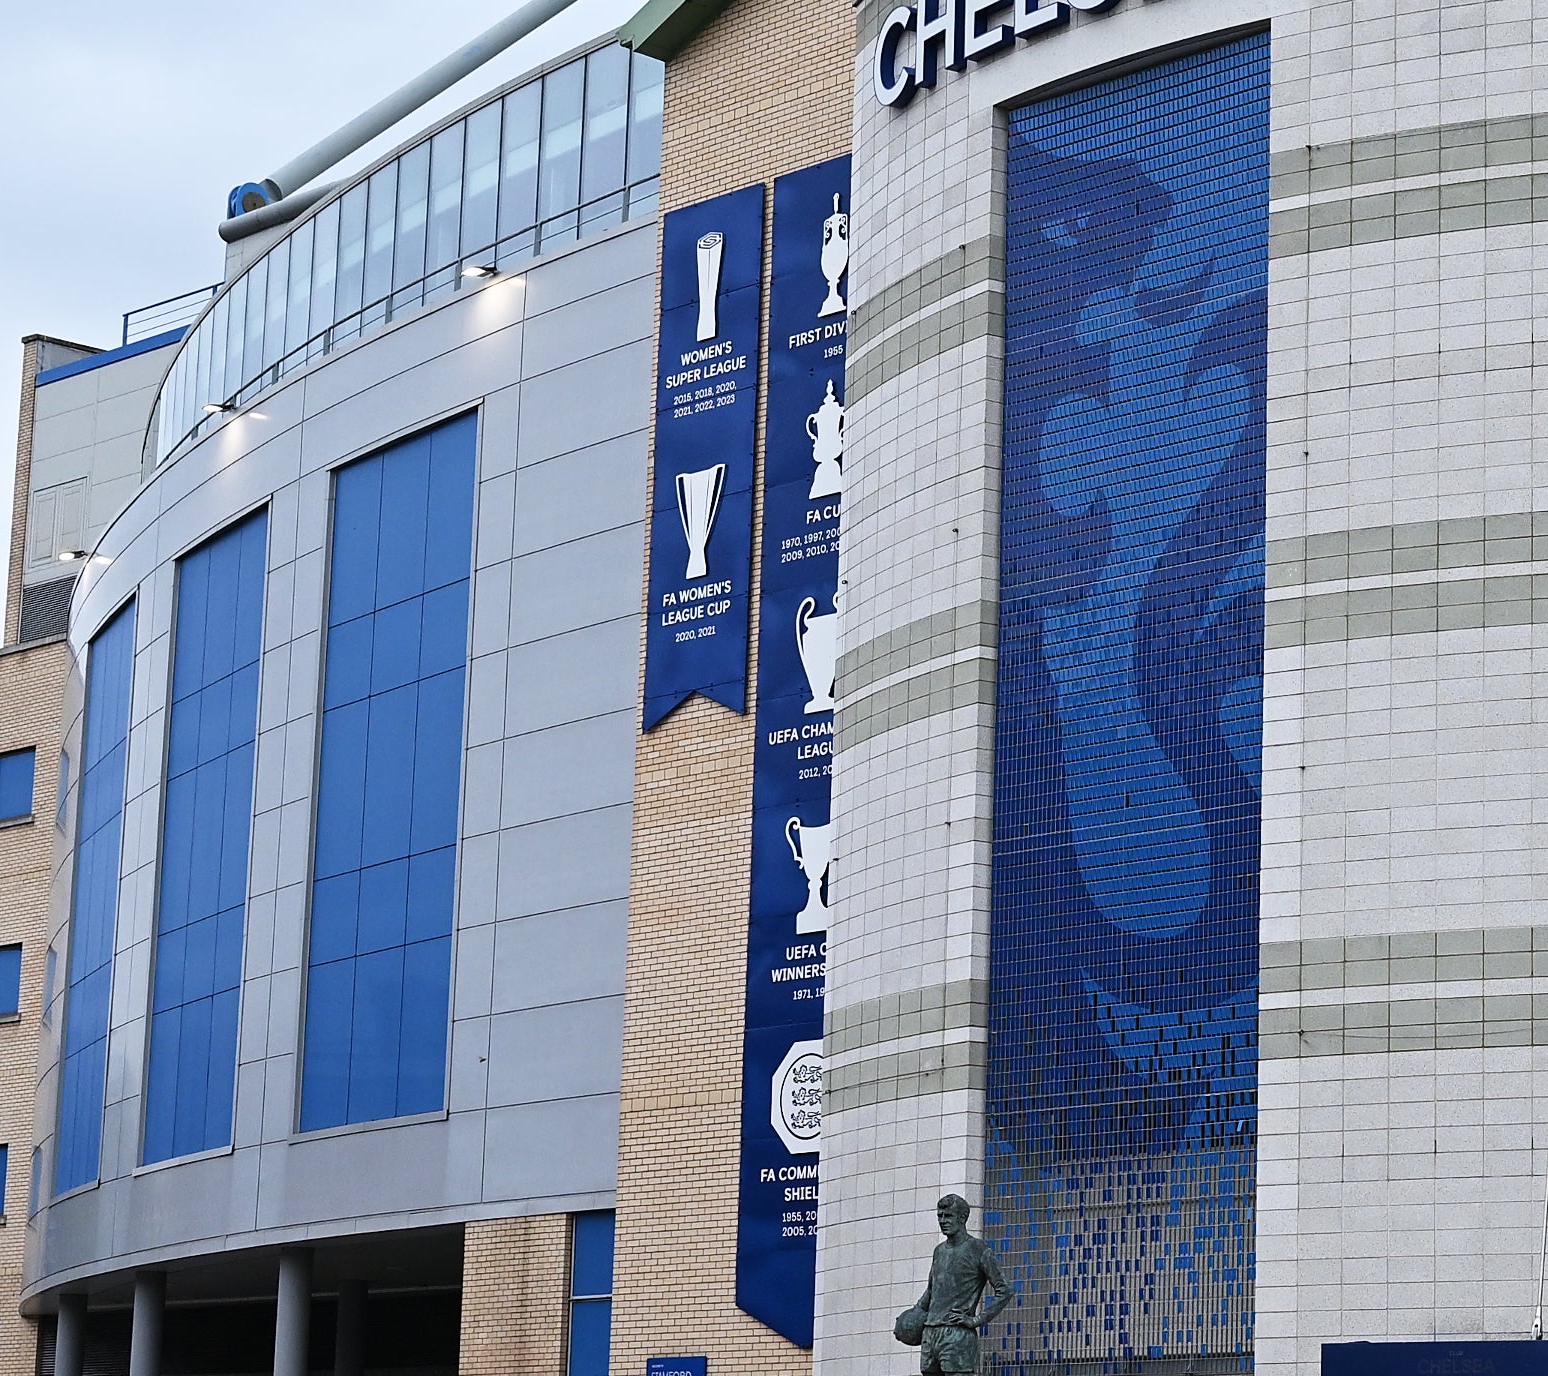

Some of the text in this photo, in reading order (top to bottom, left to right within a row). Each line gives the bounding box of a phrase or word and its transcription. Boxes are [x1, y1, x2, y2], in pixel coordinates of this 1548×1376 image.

[788, 327, 822, 350] FIRST
[680, 340, 732, 366] WOMEN'S
[823, 344, 843, 359] 1955
[665, 355, 747, 389] SUPER LEAGUE
[694, 386, 714, 400] 2018,
[715, 380, 737, 394] 2020,
[673, 393, 735, 419] 2021, 2022, 2023
[806, 509, 821, 524] FA
[781, 536, 802, 550] 1970,
[803, 530, 824, 545] 1997,
[781, 548, 804, 564] 2009,
[805, 543, 828, 558] 2010,
[662, 579, 732, 607] FA WOMEN'S
[661, 599, 731, 627] LEAGUE CUP
[675, 625, 716, 643] 2020, 2021
[769, 727, 799, 745] UEFA
[798, 766, 821, 780] 2012,
[786, 943, 817, 961] UEFA
[792, 989, 814, 1001] 1971,
[760, 1168, 776, 1183] FA
[782, 1211, 804, 1223] 1955,
[782, 1226, 807, 1237] 2005,
